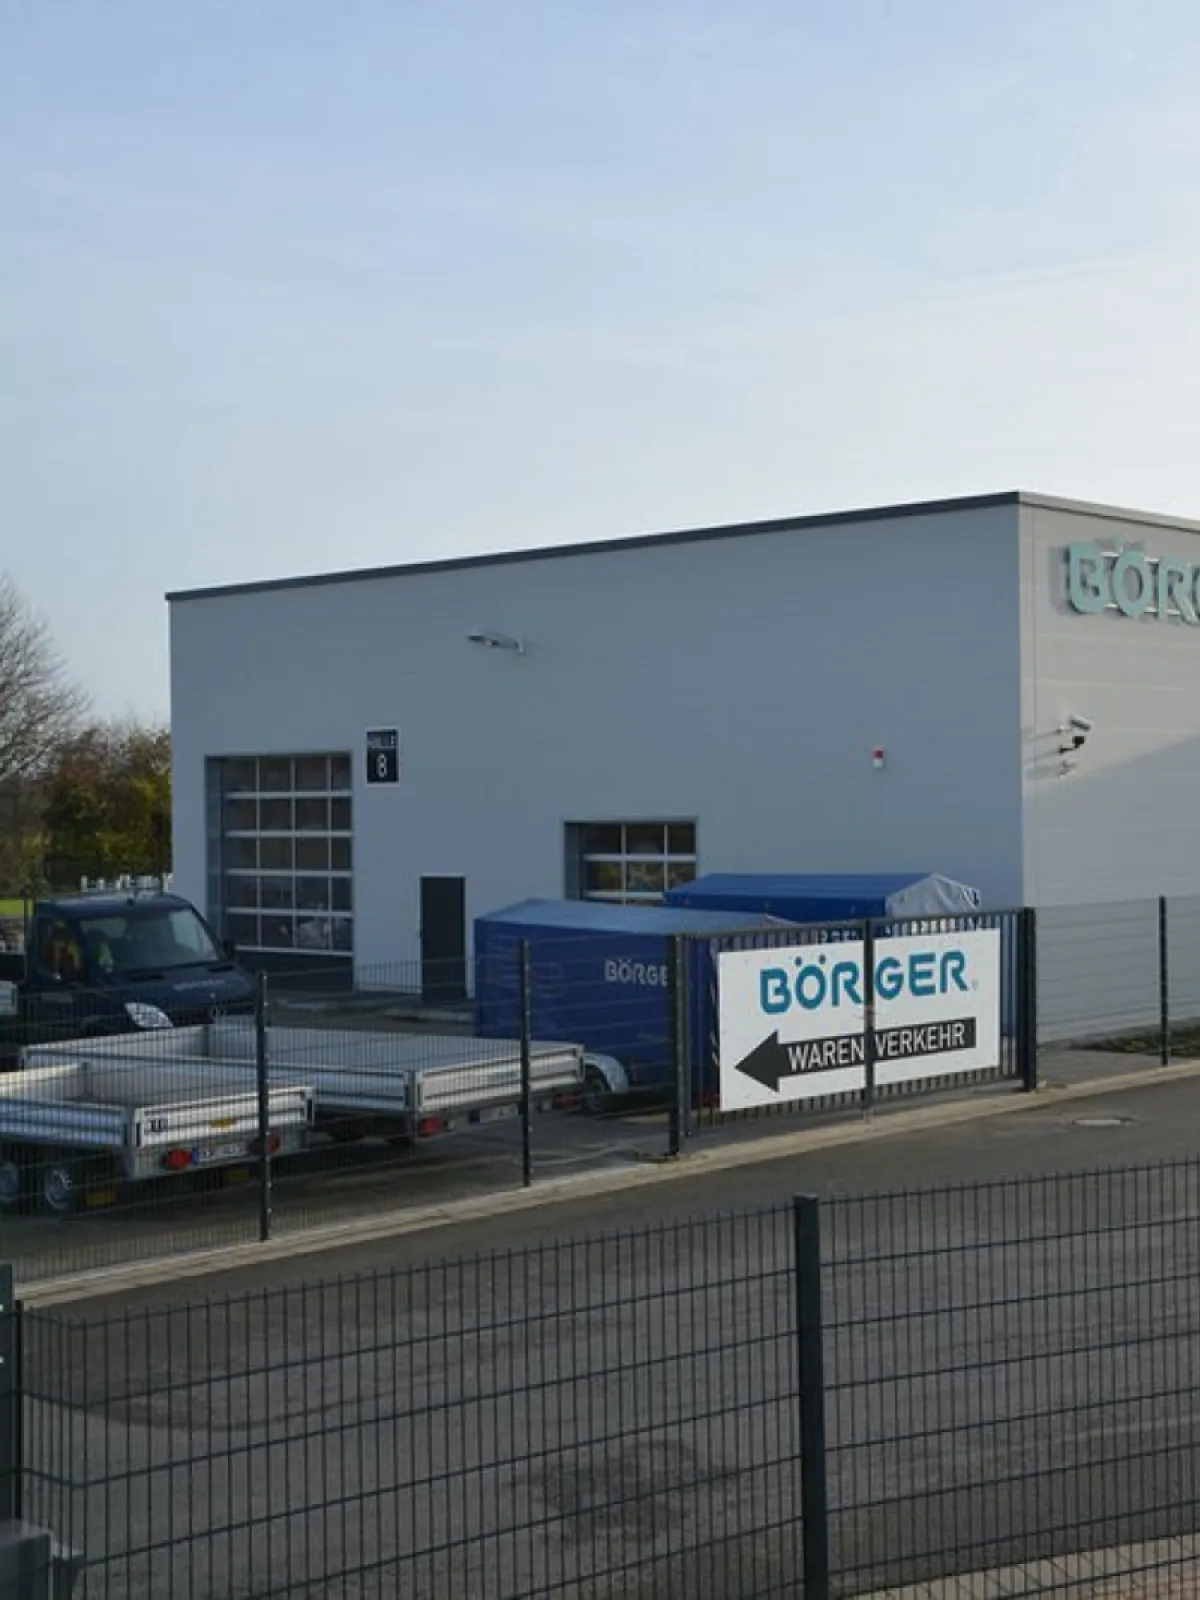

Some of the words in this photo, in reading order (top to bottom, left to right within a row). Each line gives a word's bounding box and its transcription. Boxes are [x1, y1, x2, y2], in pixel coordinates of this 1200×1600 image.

[376, 752, 388, 778] 8
[605, 958, 668, 987] BÖRGE
[760, 950, 968, 1014] BÖRGER
